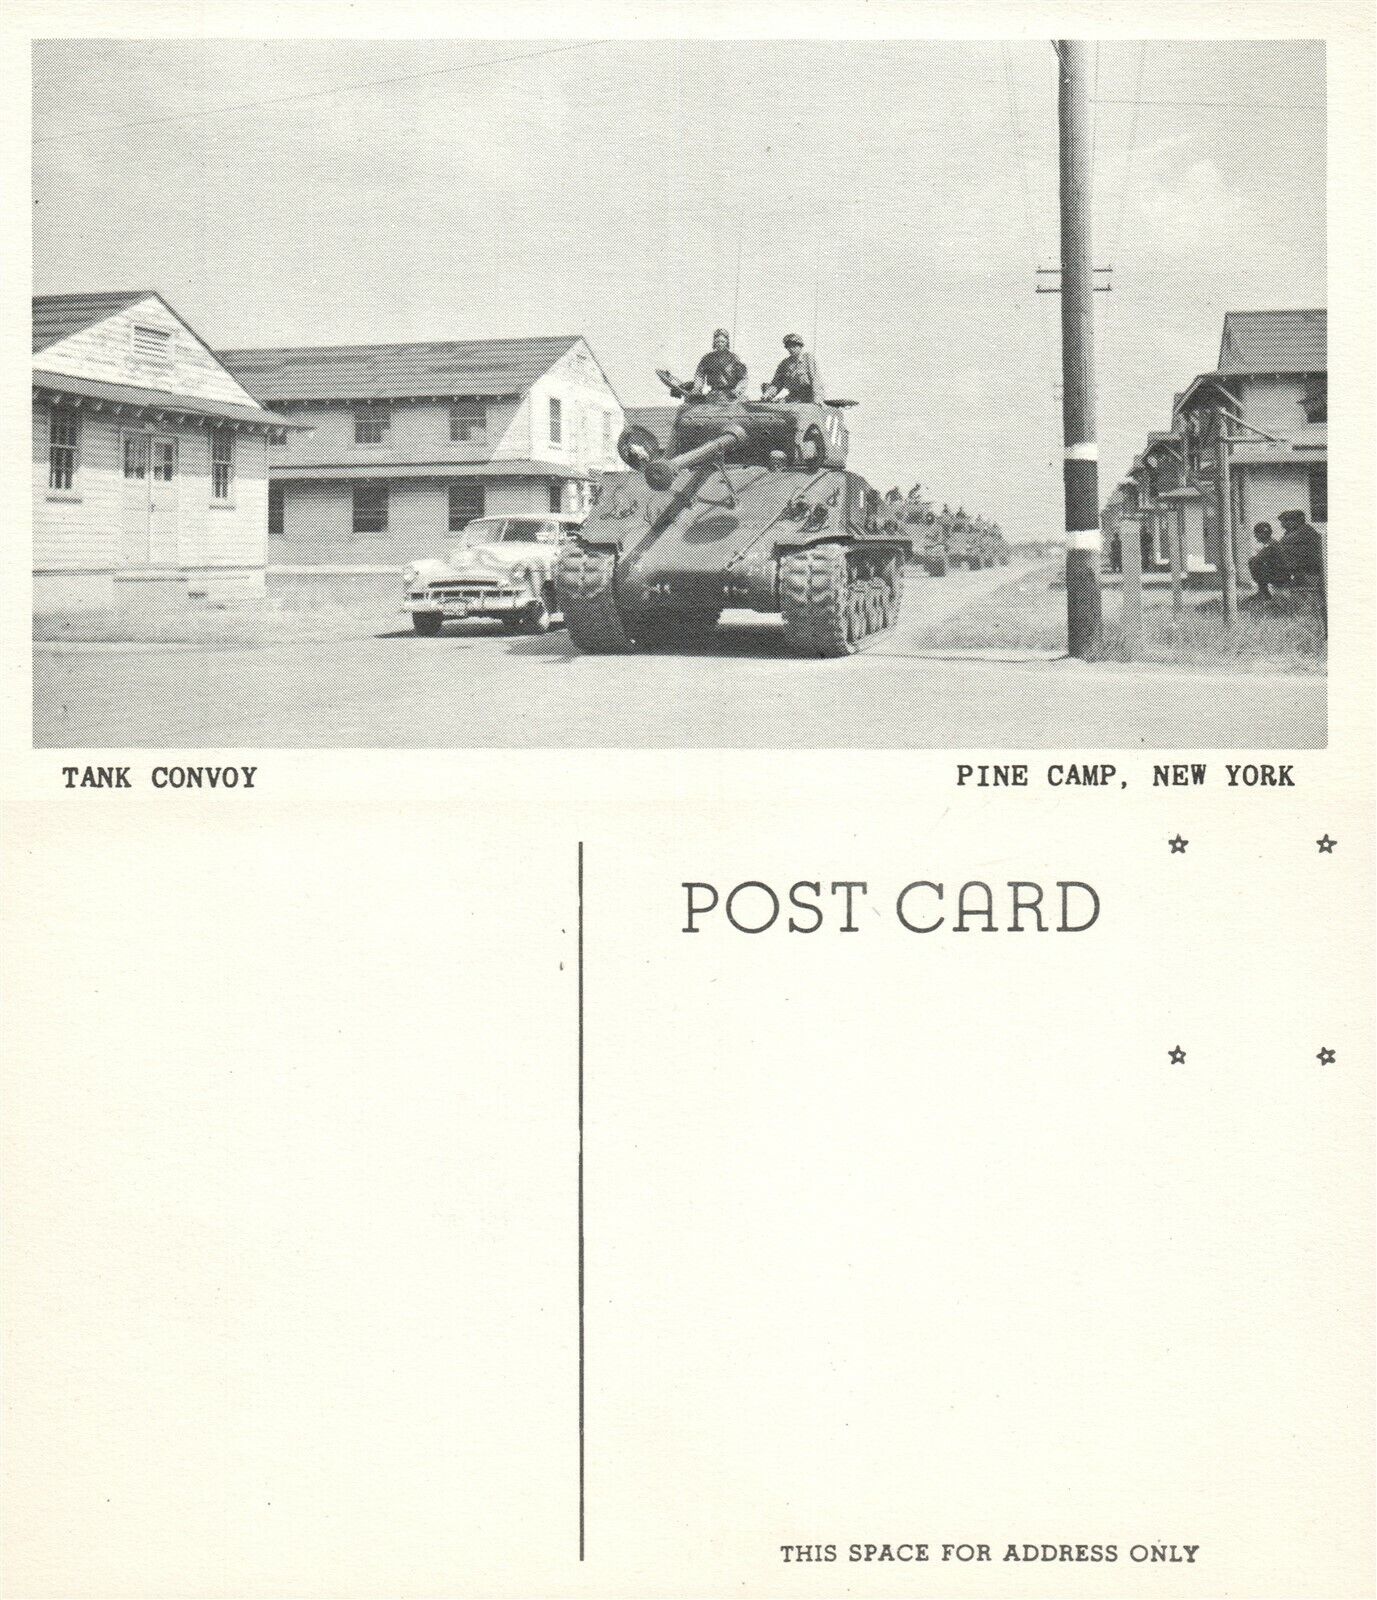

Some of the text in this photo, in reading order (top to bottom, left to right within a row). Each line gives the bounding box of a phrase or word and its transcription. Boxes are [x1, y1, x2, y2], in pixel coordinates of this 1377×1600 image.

[682, 881, 1099, 933] POST CARD
[781, 1544, 1199, 1562] THIS SPACE FOR ADDRESS ONLY
